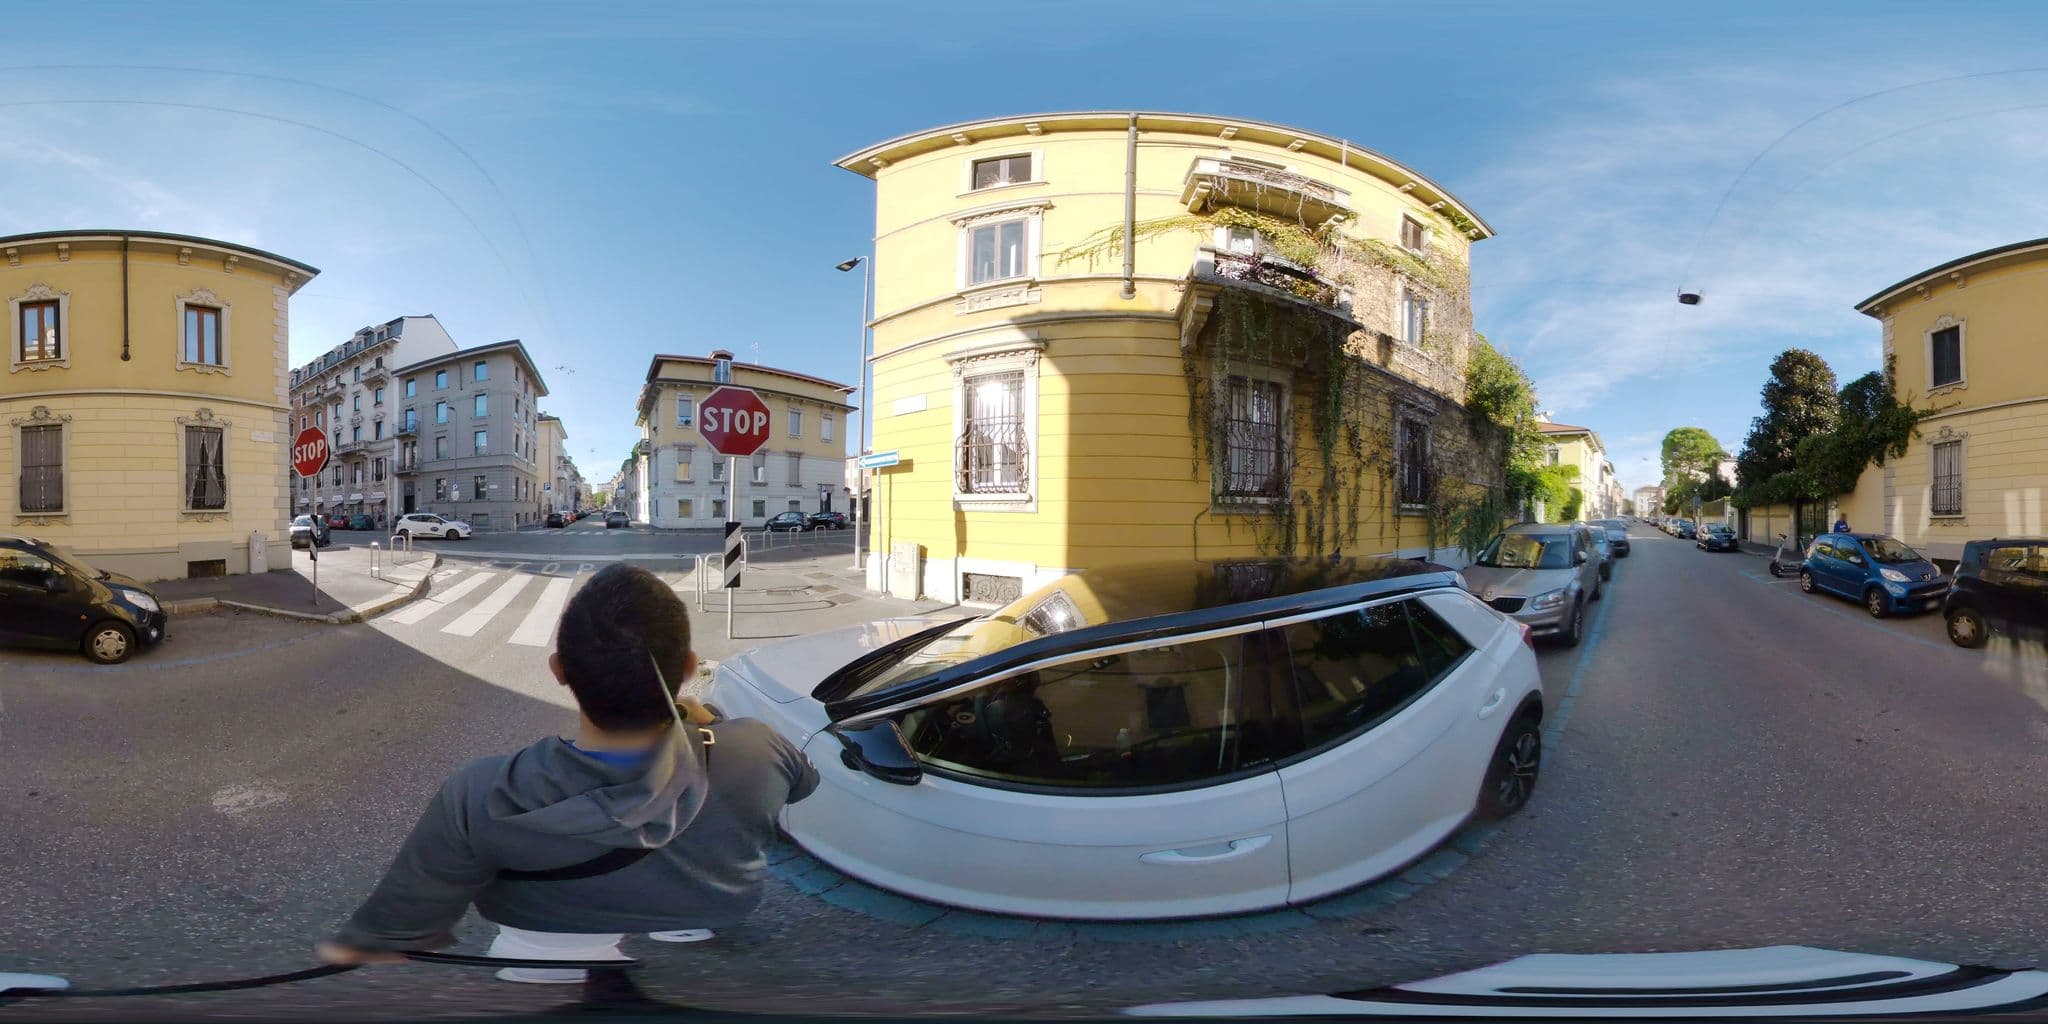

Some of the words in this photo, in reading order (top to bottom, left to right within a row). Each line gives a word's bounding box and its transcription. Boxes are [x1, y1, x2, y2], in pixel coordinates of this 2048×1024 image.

[703, 406, 767, 436] STOP
[294, 439, 325, 464] STOP
[472, 559, 595, 576] STOP
